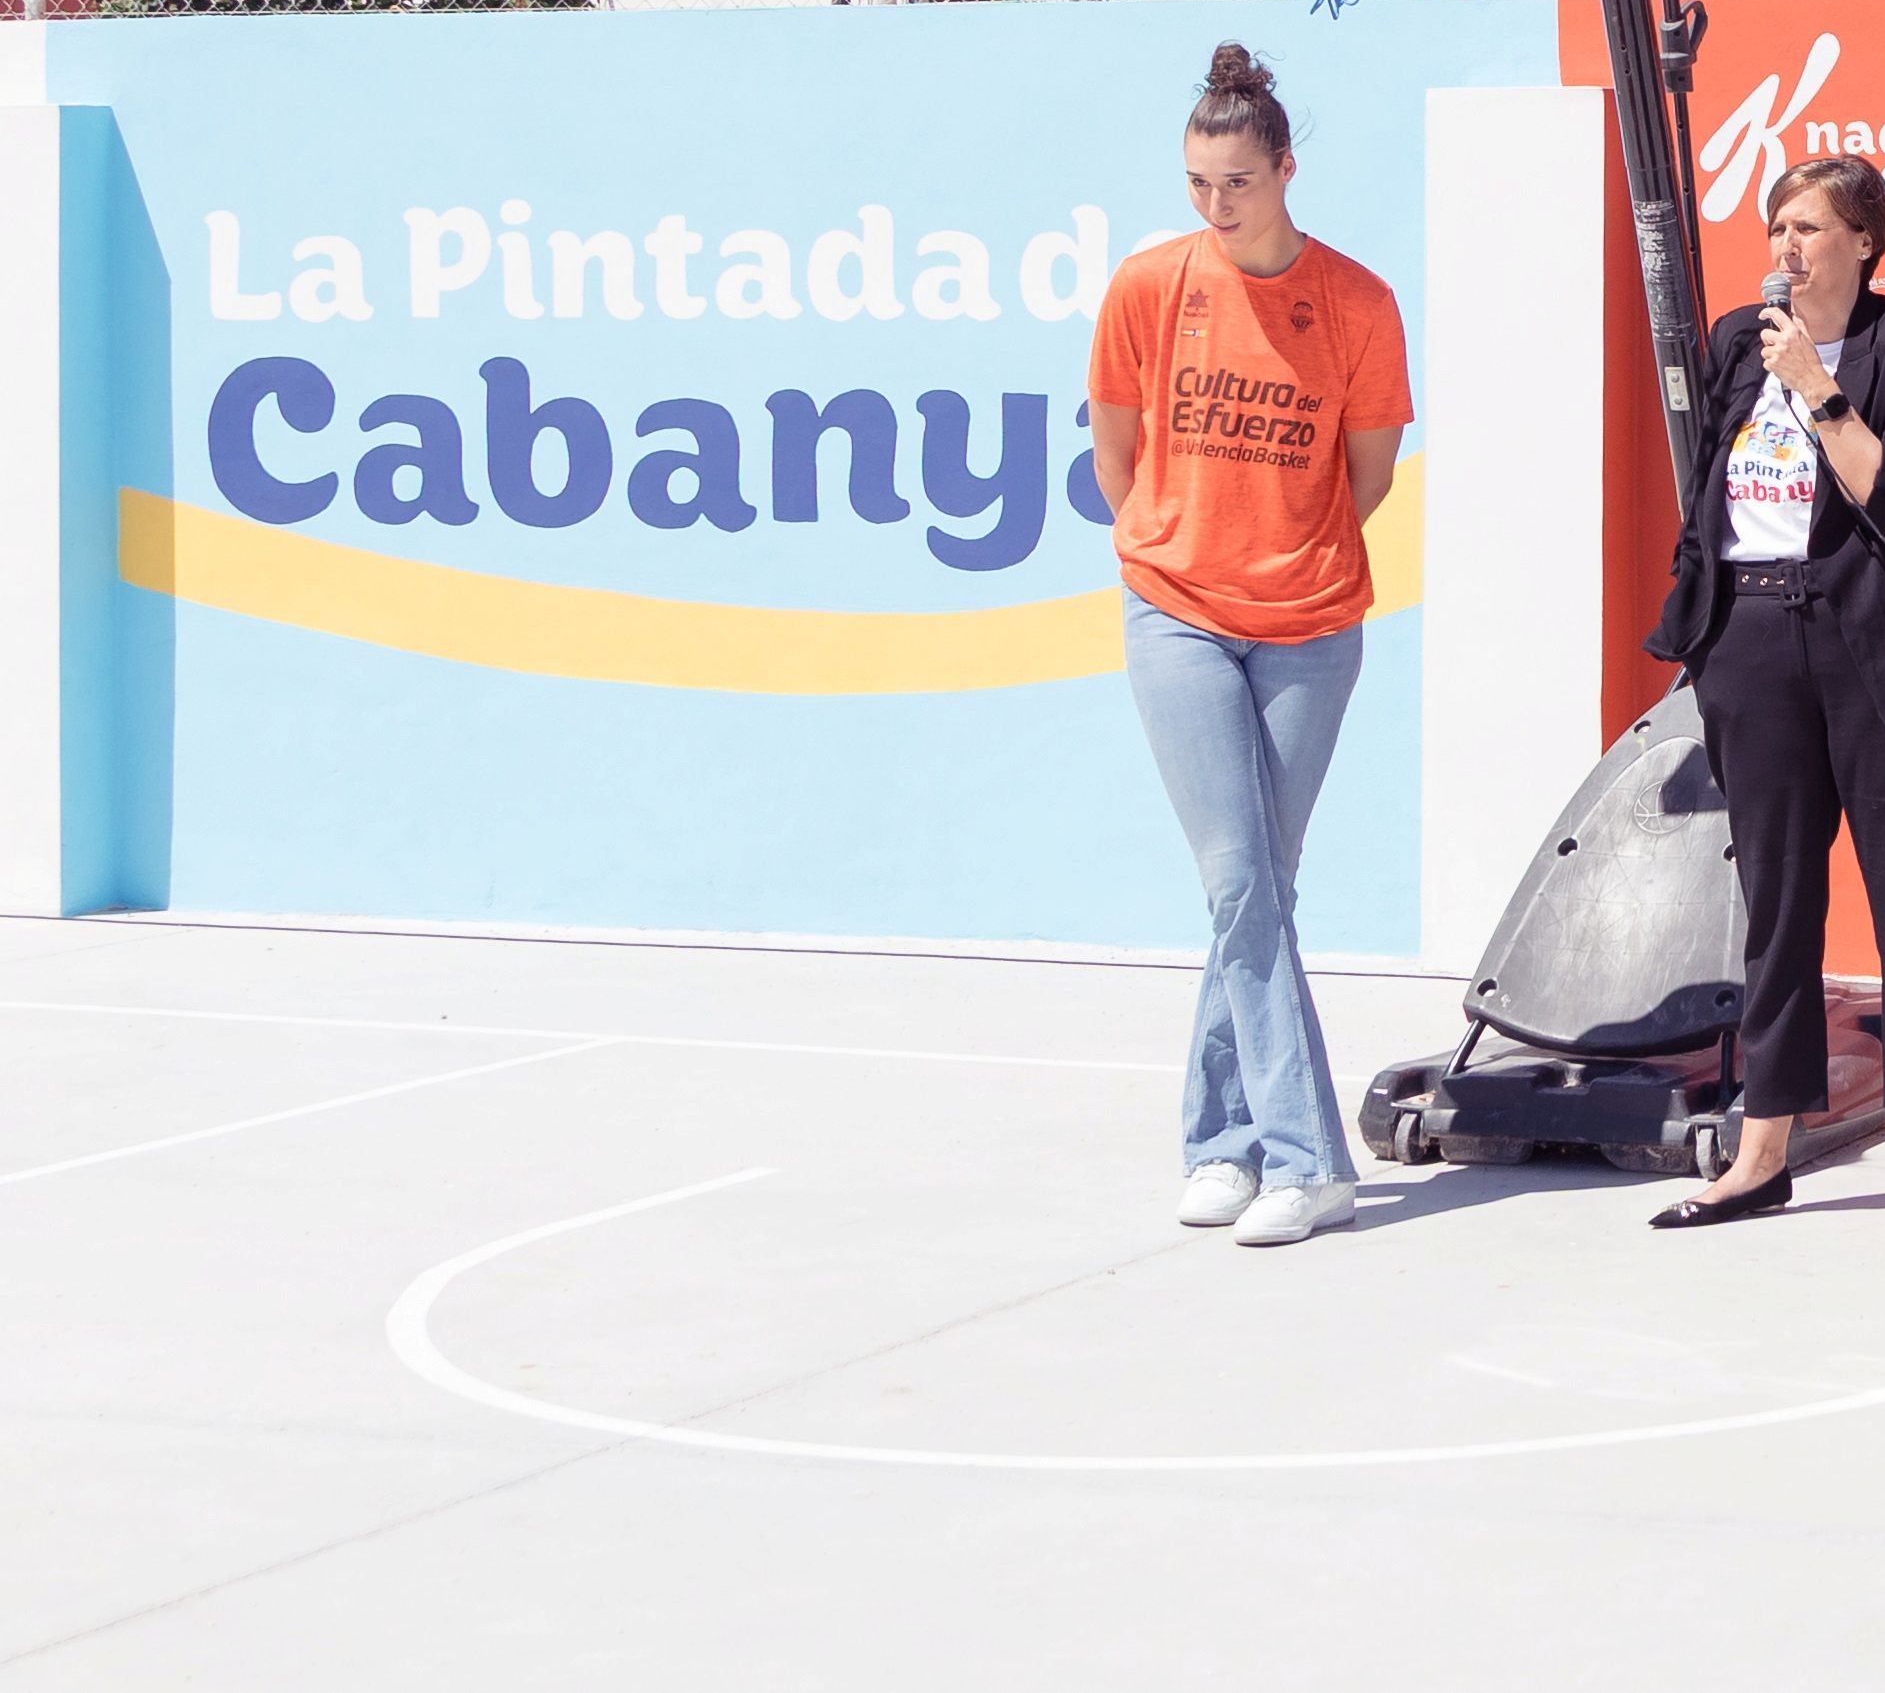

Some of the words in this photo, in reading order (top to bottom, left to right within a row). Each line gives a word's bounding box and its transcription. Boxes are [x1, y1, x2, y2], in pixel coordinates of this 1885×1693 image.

[1699, 32, 1841, 226] K
[205, 209, 374, 322] La
[403, 198, 1002, 321] Pintada
[1172, 400, 1316, 448] Esfuerzo
[1174, 366, 1296, 409] Cultura
[1296, 394, 1323, 413] del
